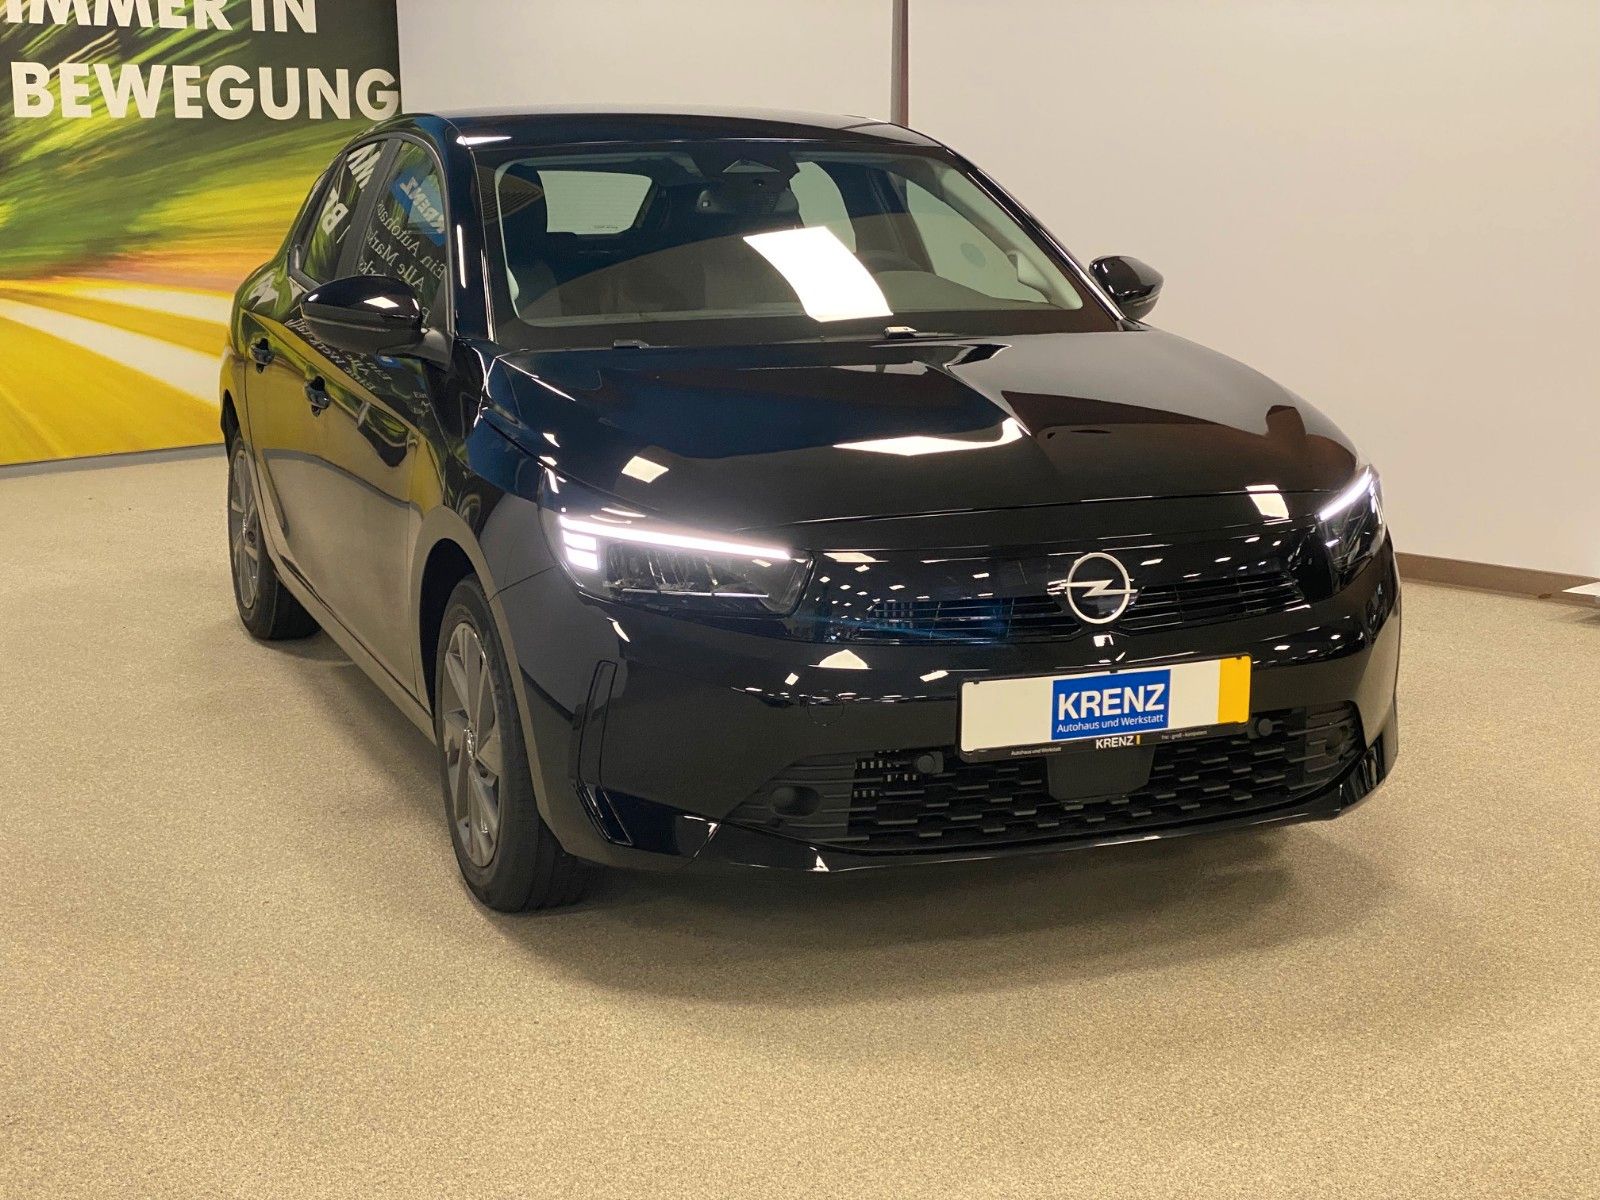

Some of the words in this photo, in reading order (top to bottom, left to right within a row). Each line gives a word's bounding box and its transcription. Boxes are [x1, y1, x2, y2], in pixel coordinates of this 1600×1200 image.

[250, 0, 317, 34] IN
[10, 61, 399, 121] BEWEGUNG
[1058, 683, 1166, 721] KRENZ
[1056, 721, 1100, 733] Autohaus
[1101, 717, 1119, 729] und
[1120, 714, 1164, 726] Werkstatt
[1095, 735, 1135, 750] KRENZ
